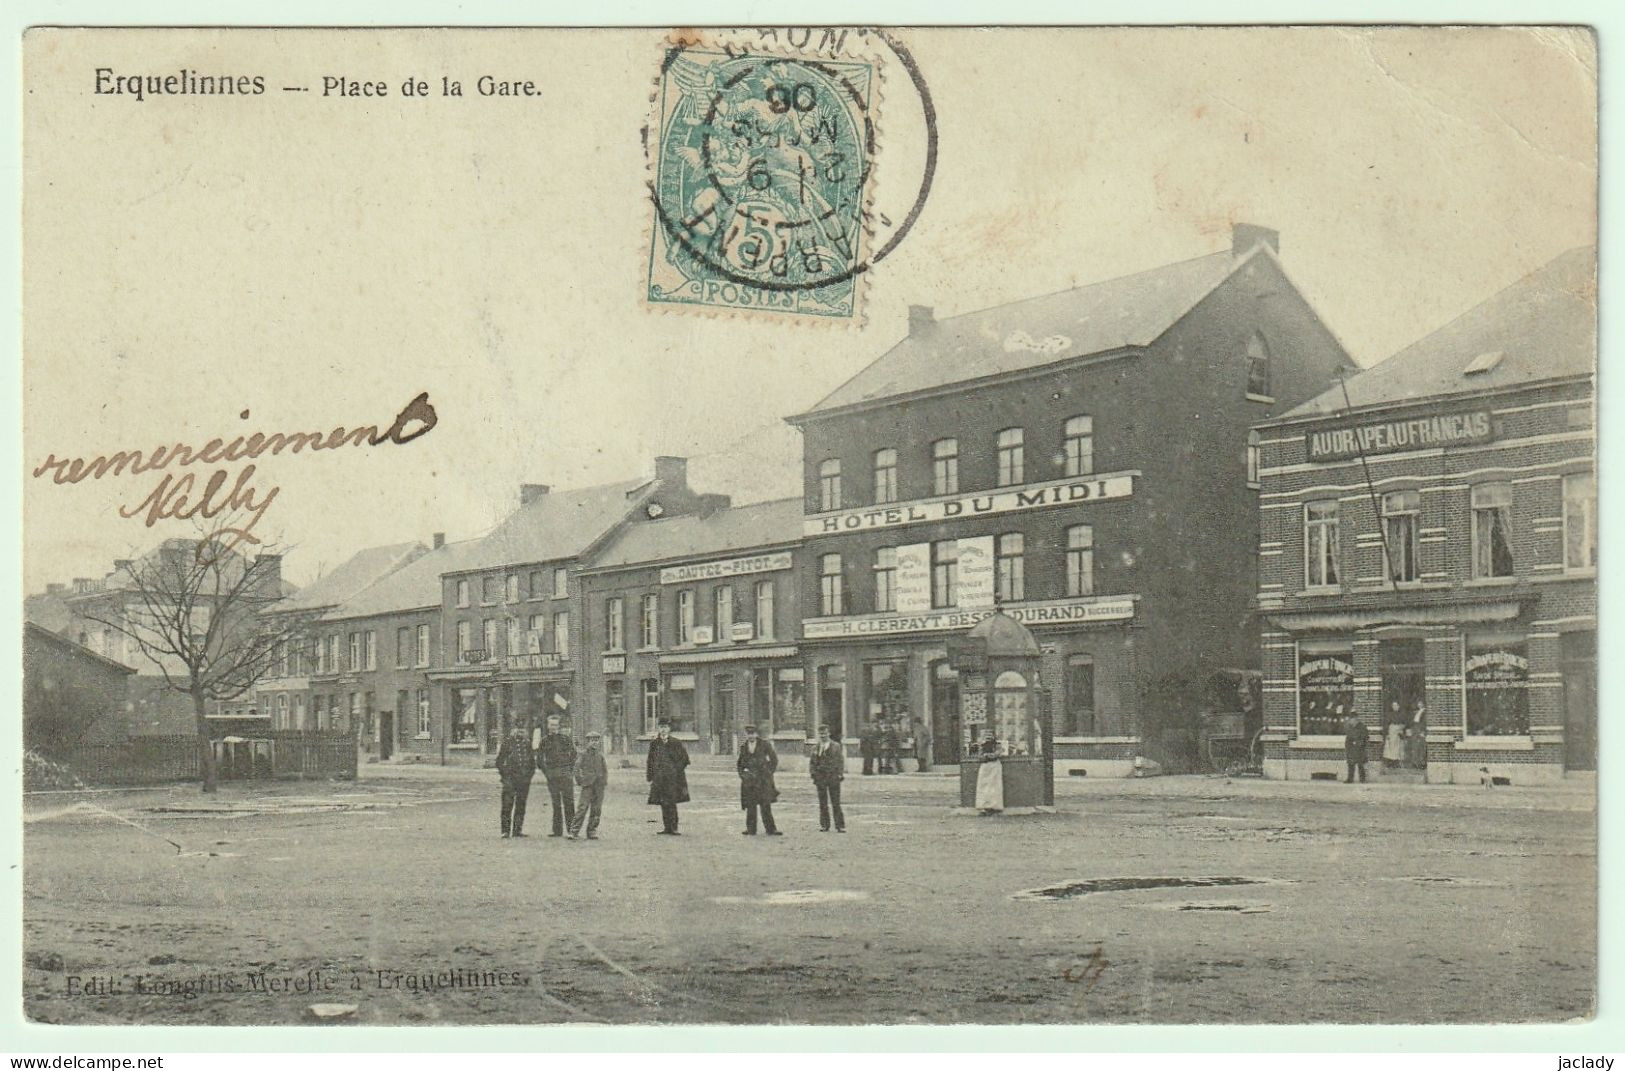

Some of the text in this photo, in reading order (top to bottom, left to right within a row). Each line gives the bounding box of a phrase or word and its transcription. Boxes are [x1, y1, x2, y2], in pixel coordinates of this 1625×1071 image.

[704, 281, 796, 307] POSTES
[943, 496, 994, 517] DU
[1016, 481, 1107, 507] MIDI
[1012, 606, 1086, 622] DURAND
